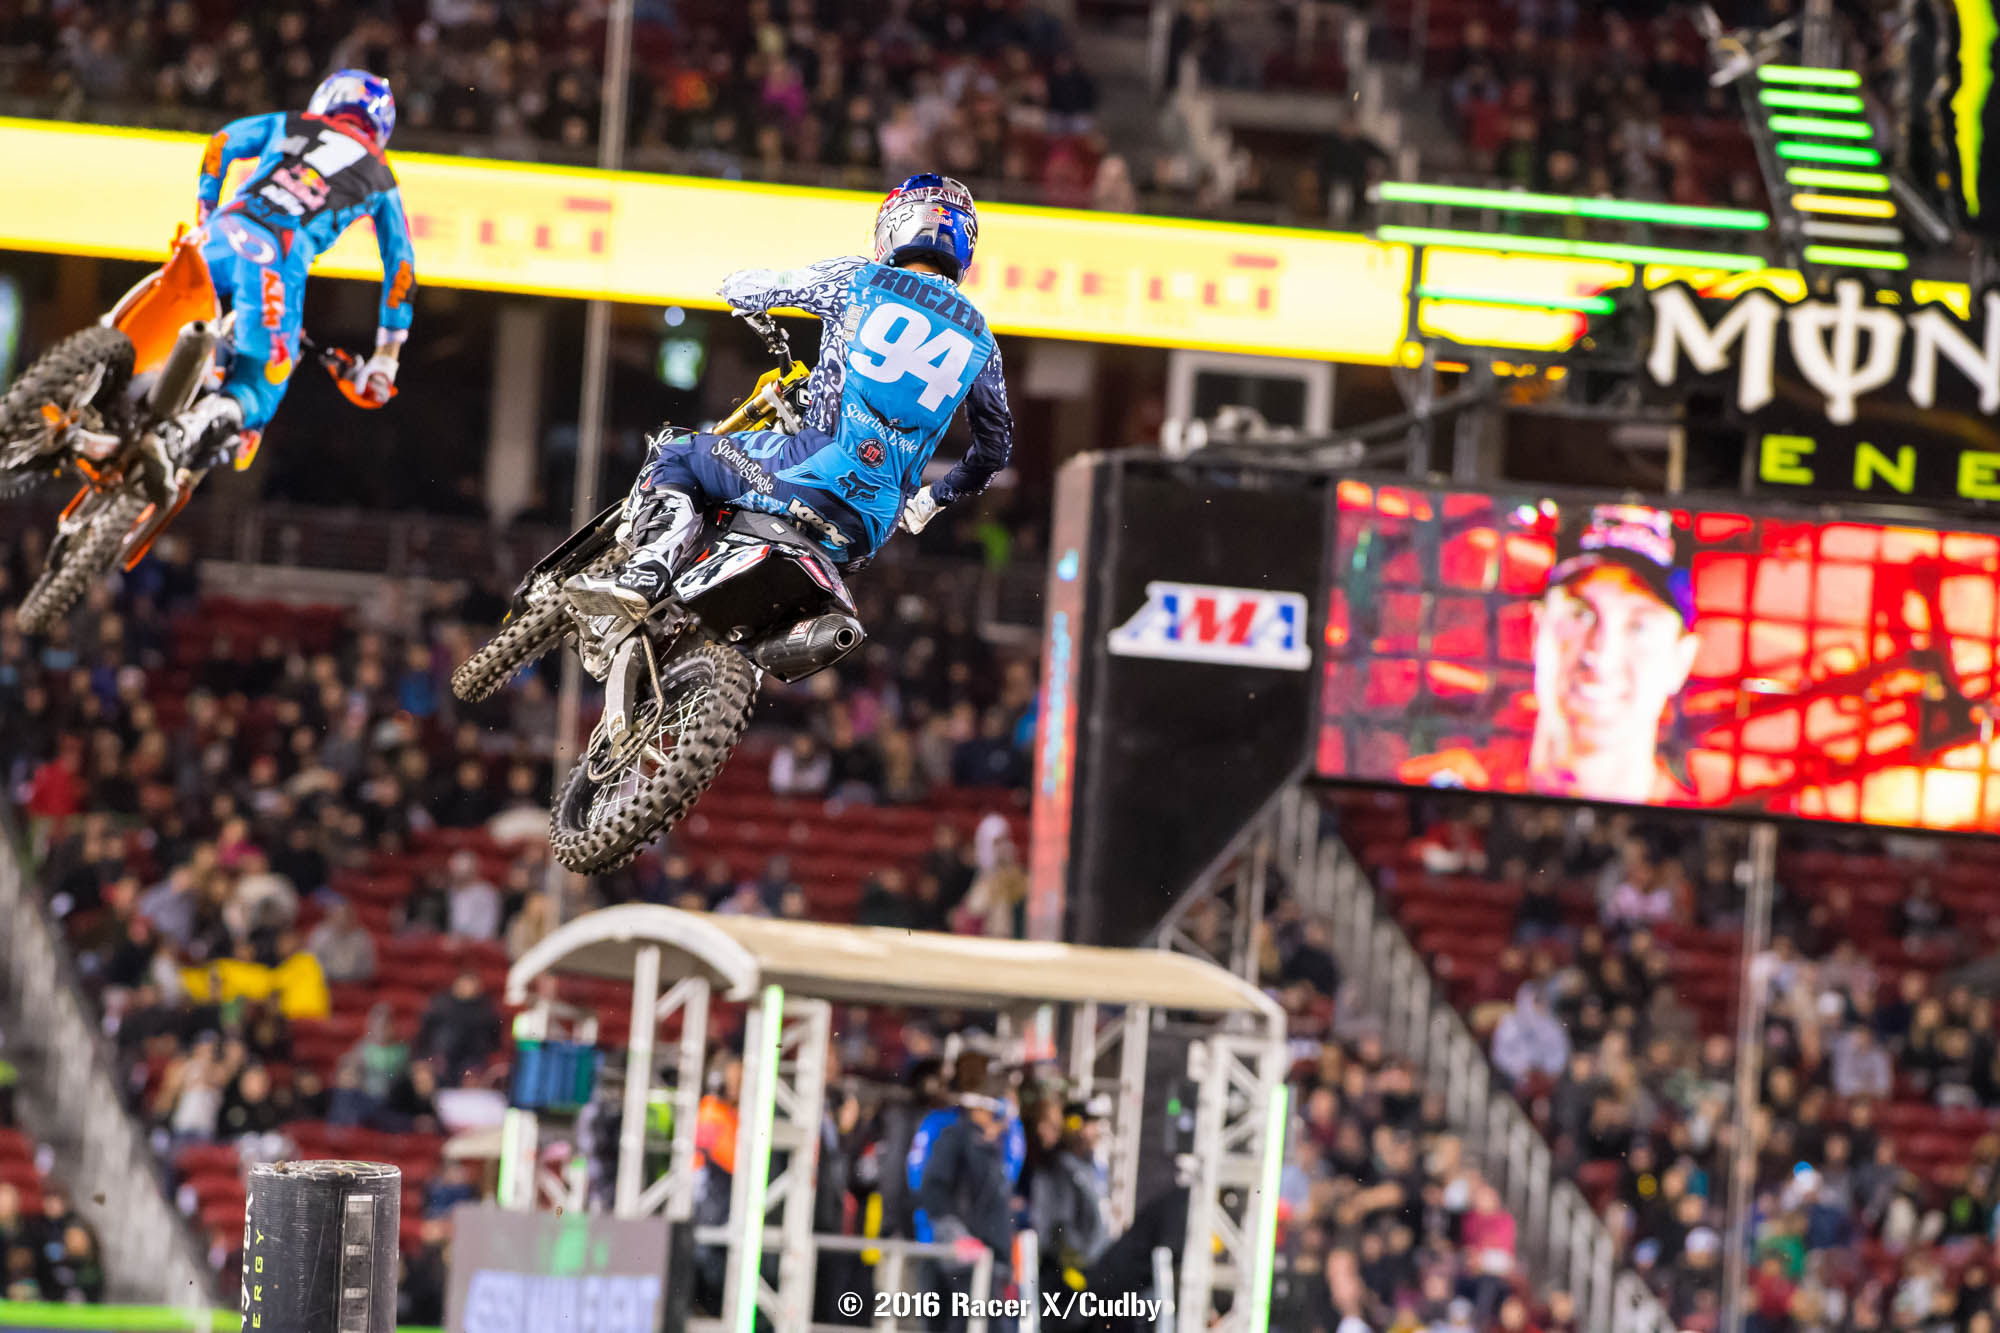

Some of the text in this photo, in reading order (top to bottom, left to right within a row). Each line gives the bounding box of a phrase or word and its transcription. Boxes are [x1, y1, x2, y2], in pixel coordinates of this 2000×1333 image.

[303, 129, 368, 177] 1
[869, 268, 985, 338] ROCZEN
[849, 303, 975, 413] 94
[1760, 434, 2000, 501] ENE
[1122, 593, 1300, 656] AMA
